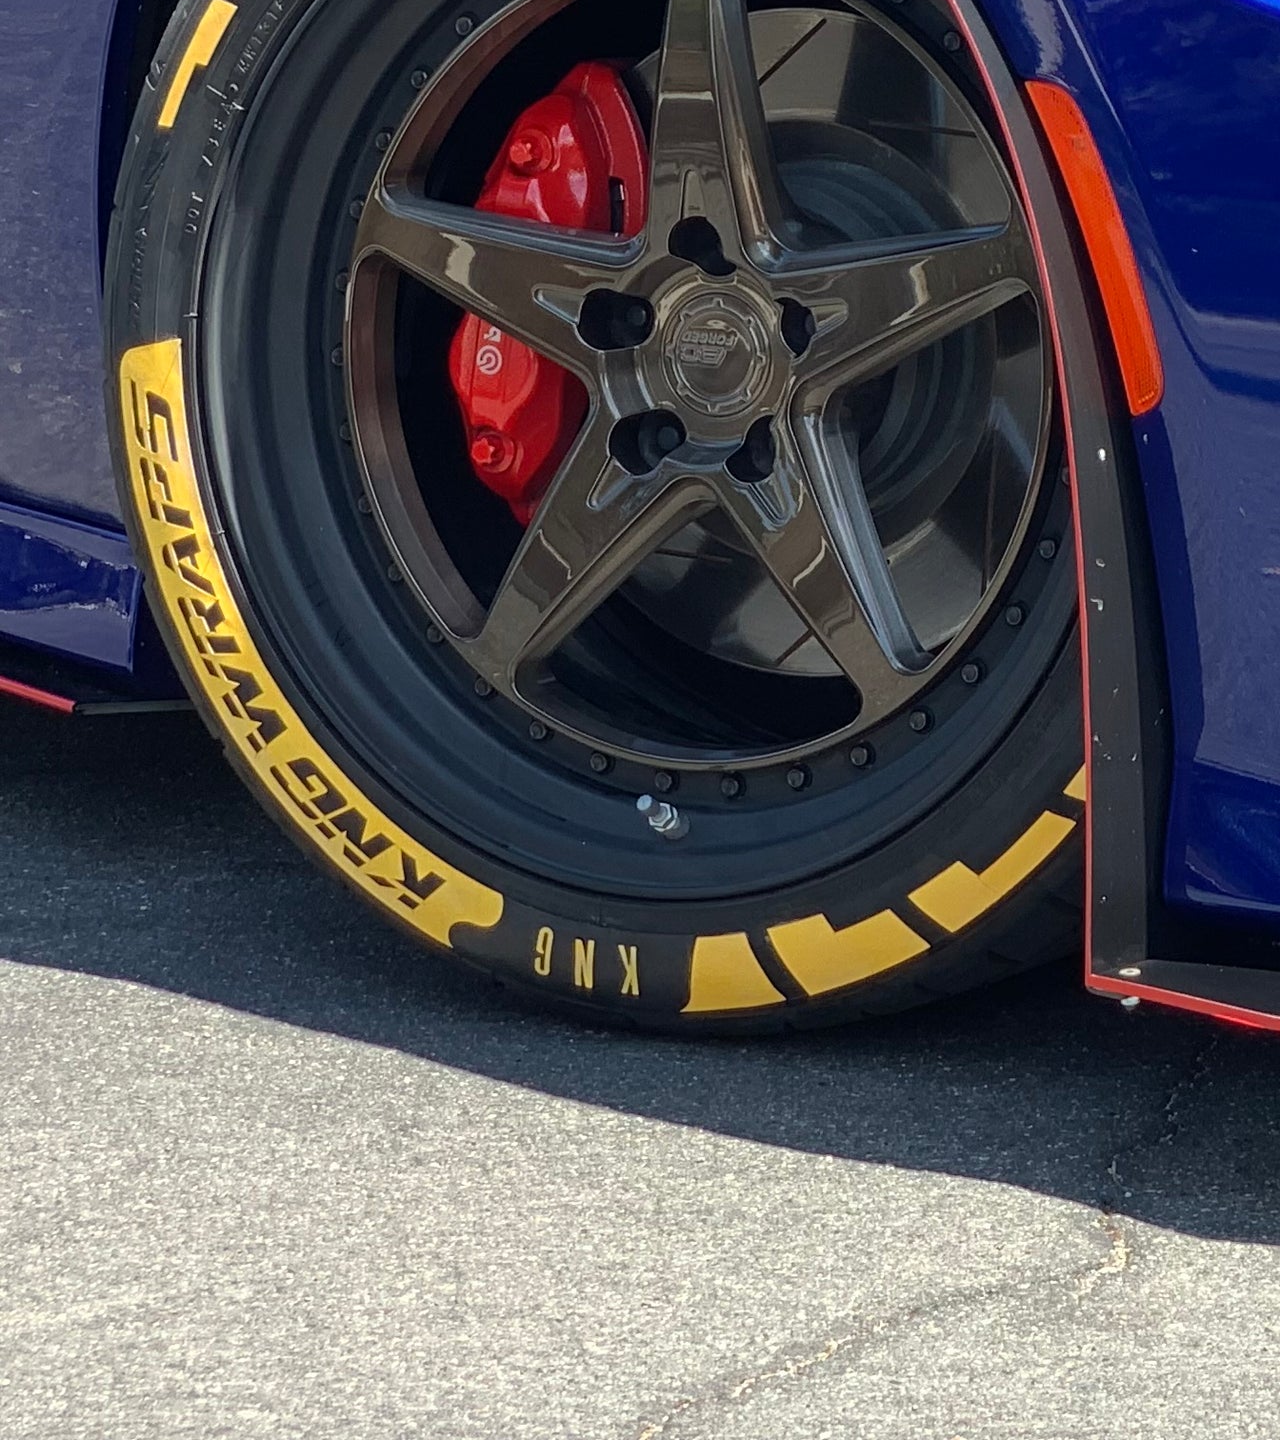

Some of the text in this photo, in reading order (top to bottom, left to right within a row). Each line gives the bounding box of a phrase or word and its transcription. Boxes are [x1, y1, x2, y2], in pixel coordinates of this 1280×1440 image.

[681, 330, 735, 347] FORGED
[131, 380, 447, 911] KNG WRAPS
[534, 925, 640, 996] KNG
